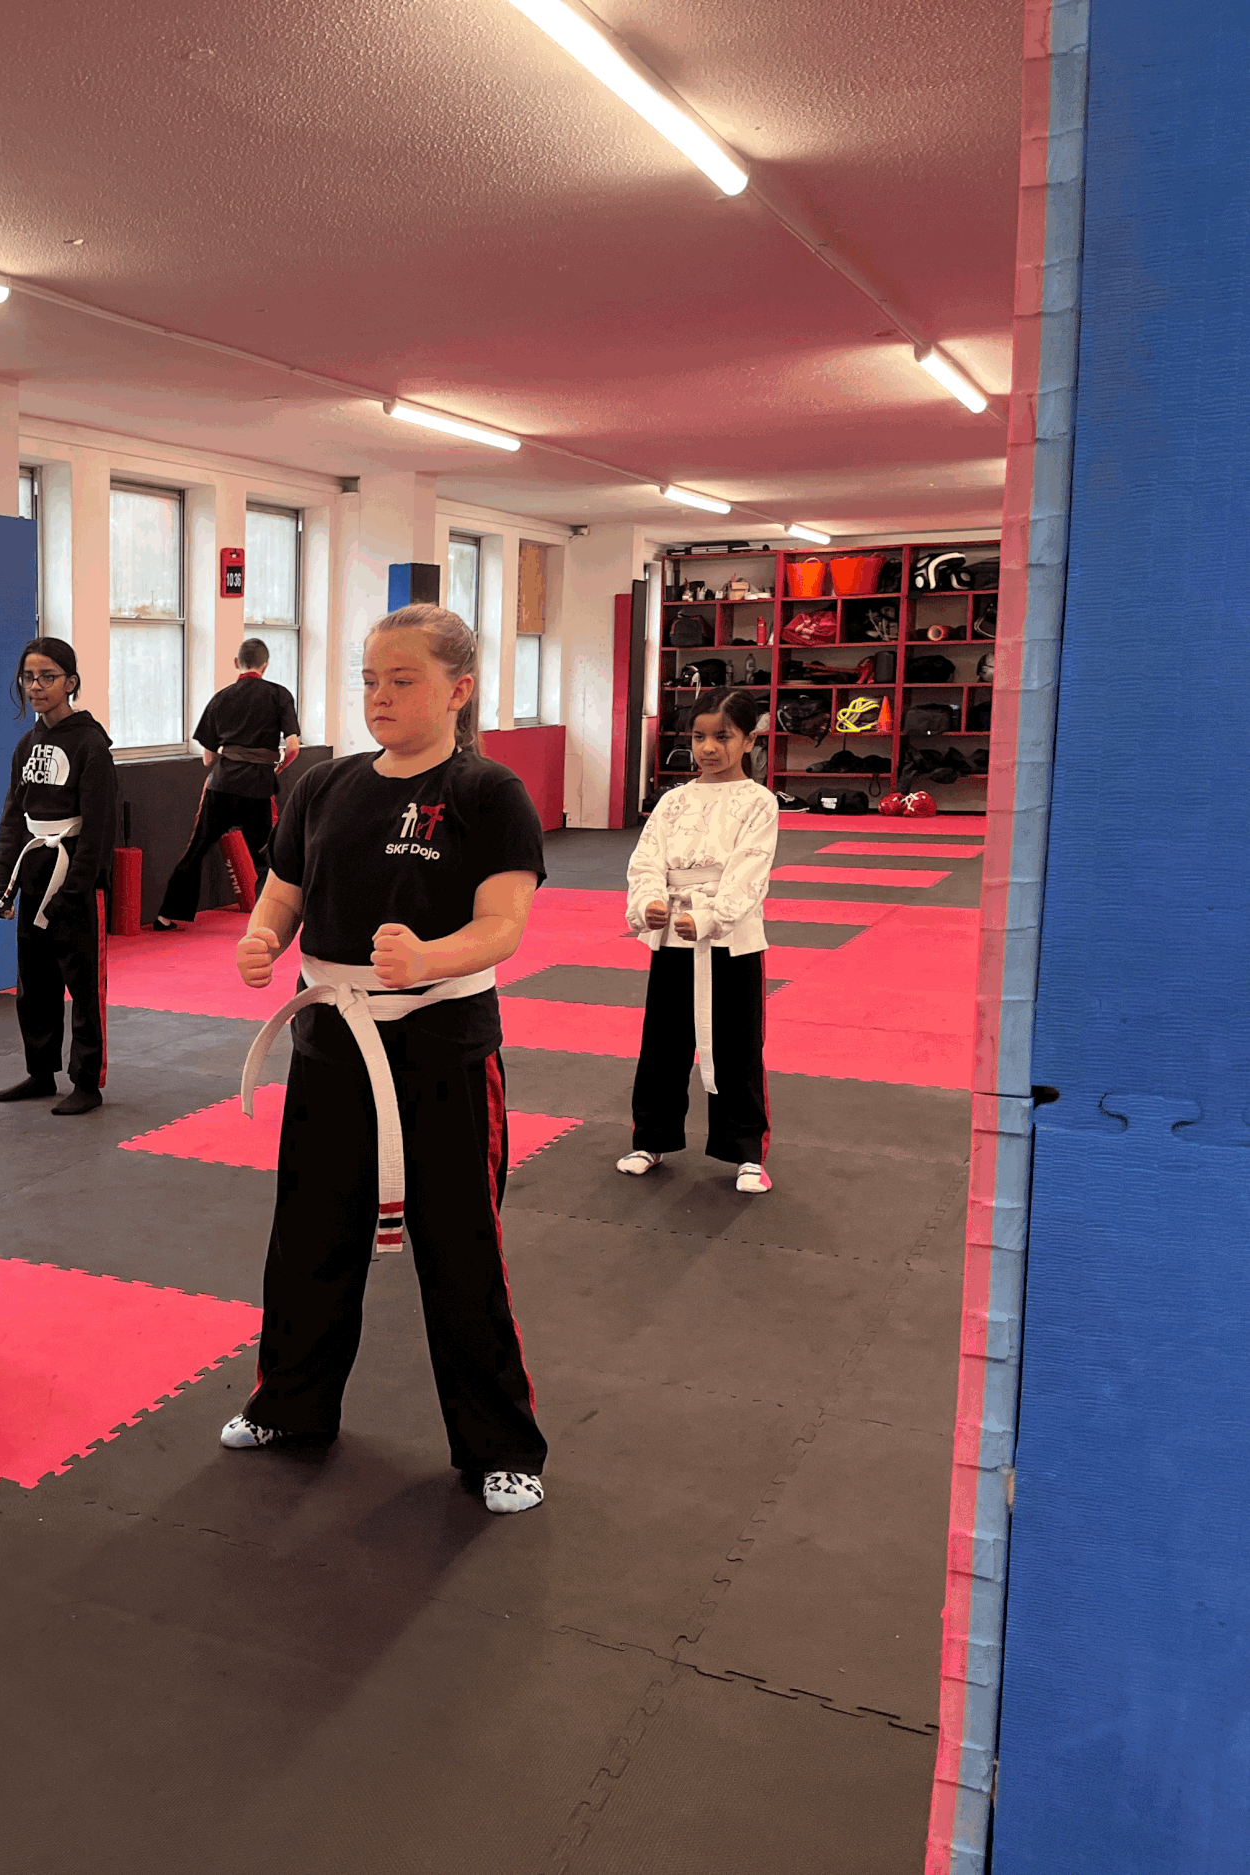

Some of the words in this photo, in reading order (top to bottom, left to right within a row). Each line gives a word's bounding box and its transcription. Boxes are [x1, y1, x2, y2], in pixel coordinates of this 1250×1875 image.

[31, 744, 54, 758] THE
[22, 769, 52, 785] FACE
[385, 843, 409, 854] SKF
[410, 843, 440, 860] Dojo
